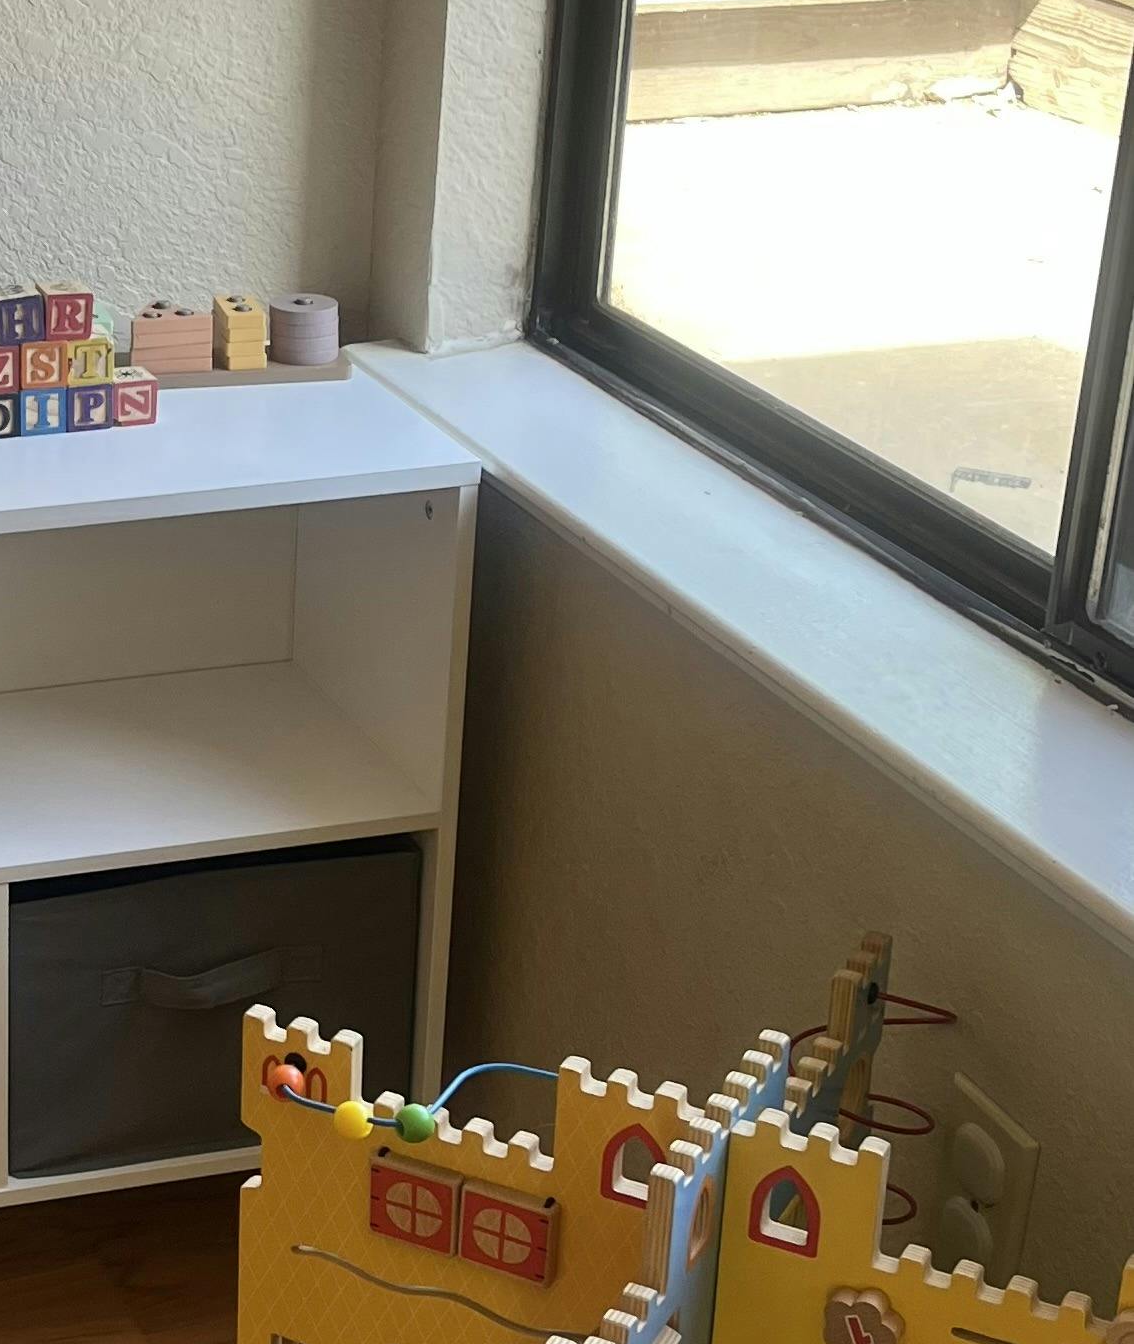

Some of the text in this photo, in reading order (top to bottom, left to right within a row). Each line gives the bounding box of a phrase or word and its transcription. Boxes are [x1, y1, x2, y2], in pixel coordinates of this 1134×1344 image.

[3, 299, 86, 340] H R
[30, 349, 57, 383] S
[77, 346, 107, 379] T
[34, 394, 52, 427] I
[79, 393, 105, 423] P
